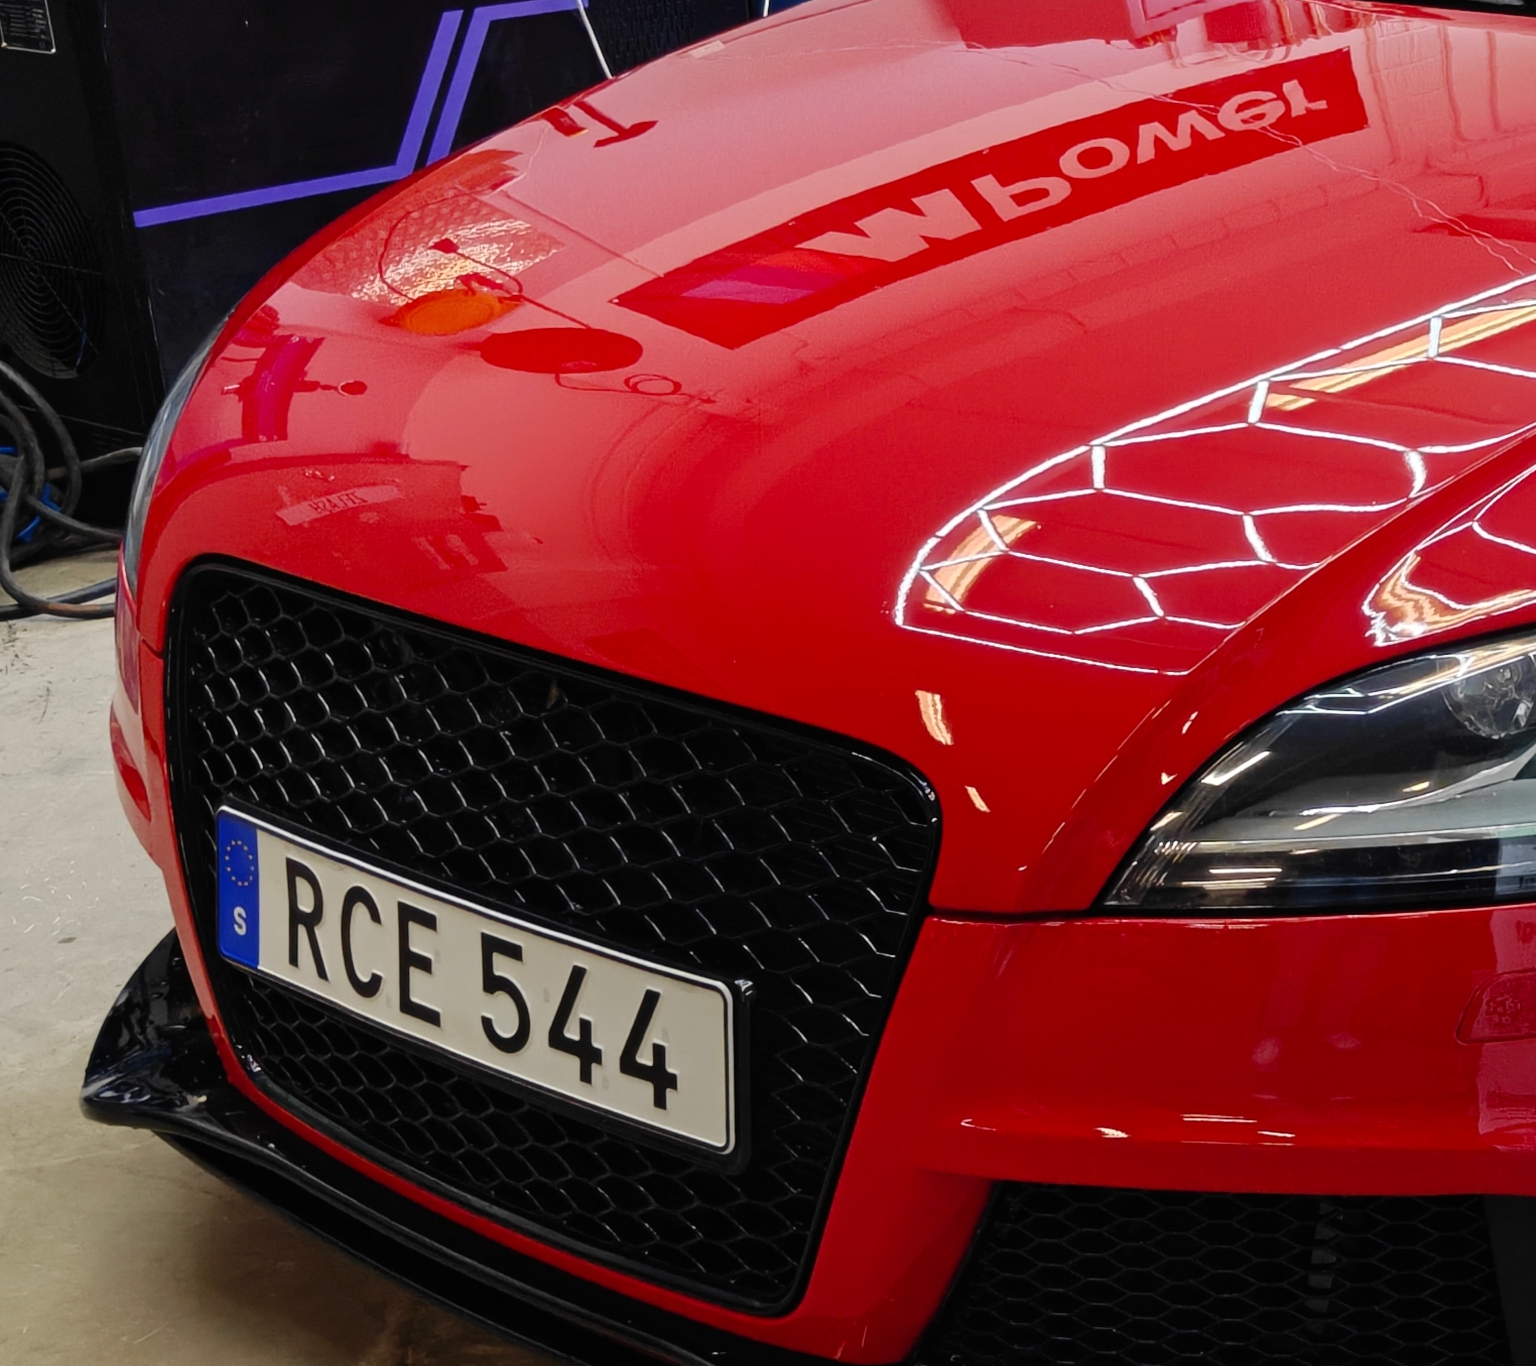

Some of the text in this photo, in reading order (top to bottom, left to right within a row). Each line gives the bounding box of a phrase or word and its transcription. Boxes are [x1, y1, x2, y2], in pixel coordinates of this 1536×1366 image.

[232, 906, 247, 936] S
[285, 857, 679, 1112] RCE 544
